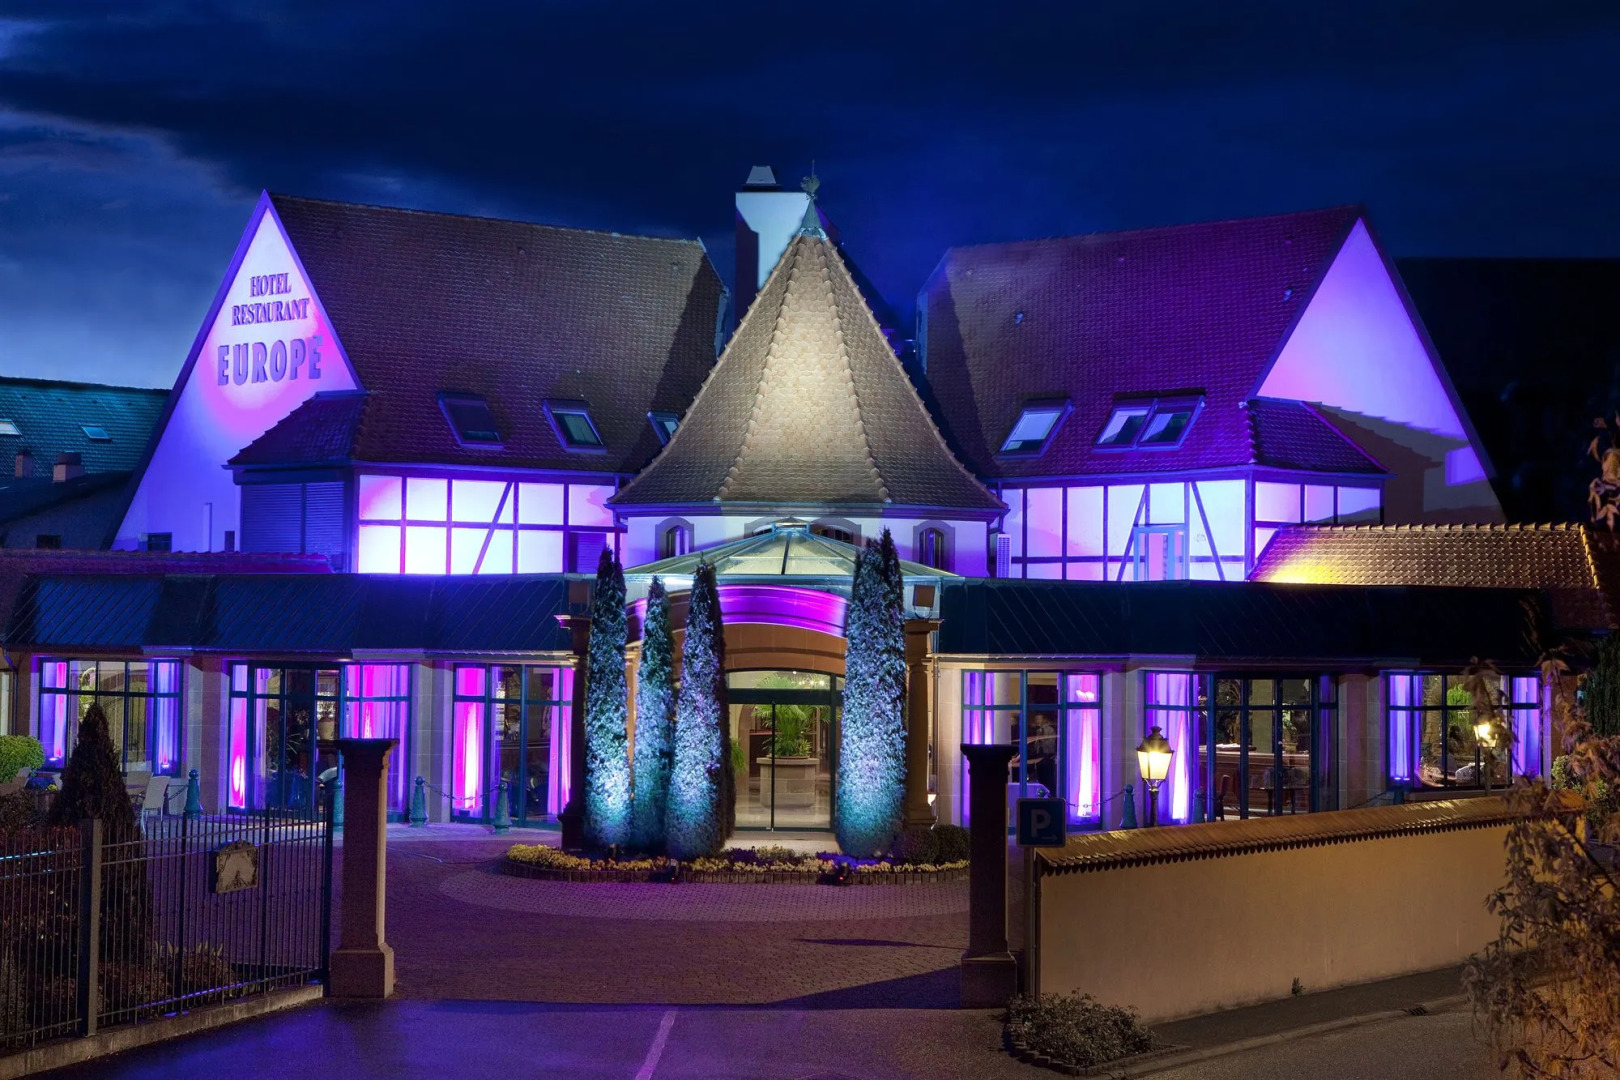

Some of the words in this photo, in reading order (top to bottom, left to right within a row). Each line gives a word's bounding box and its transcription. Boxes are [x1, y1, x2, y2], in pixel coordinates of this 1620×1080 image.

[250, 272, 292, 297] HOTEL
[231, 298, 310, 326] RESTAURANT
[217, 334, 323, 387] EUROPE
[1031, 808, 1051, 838] P
